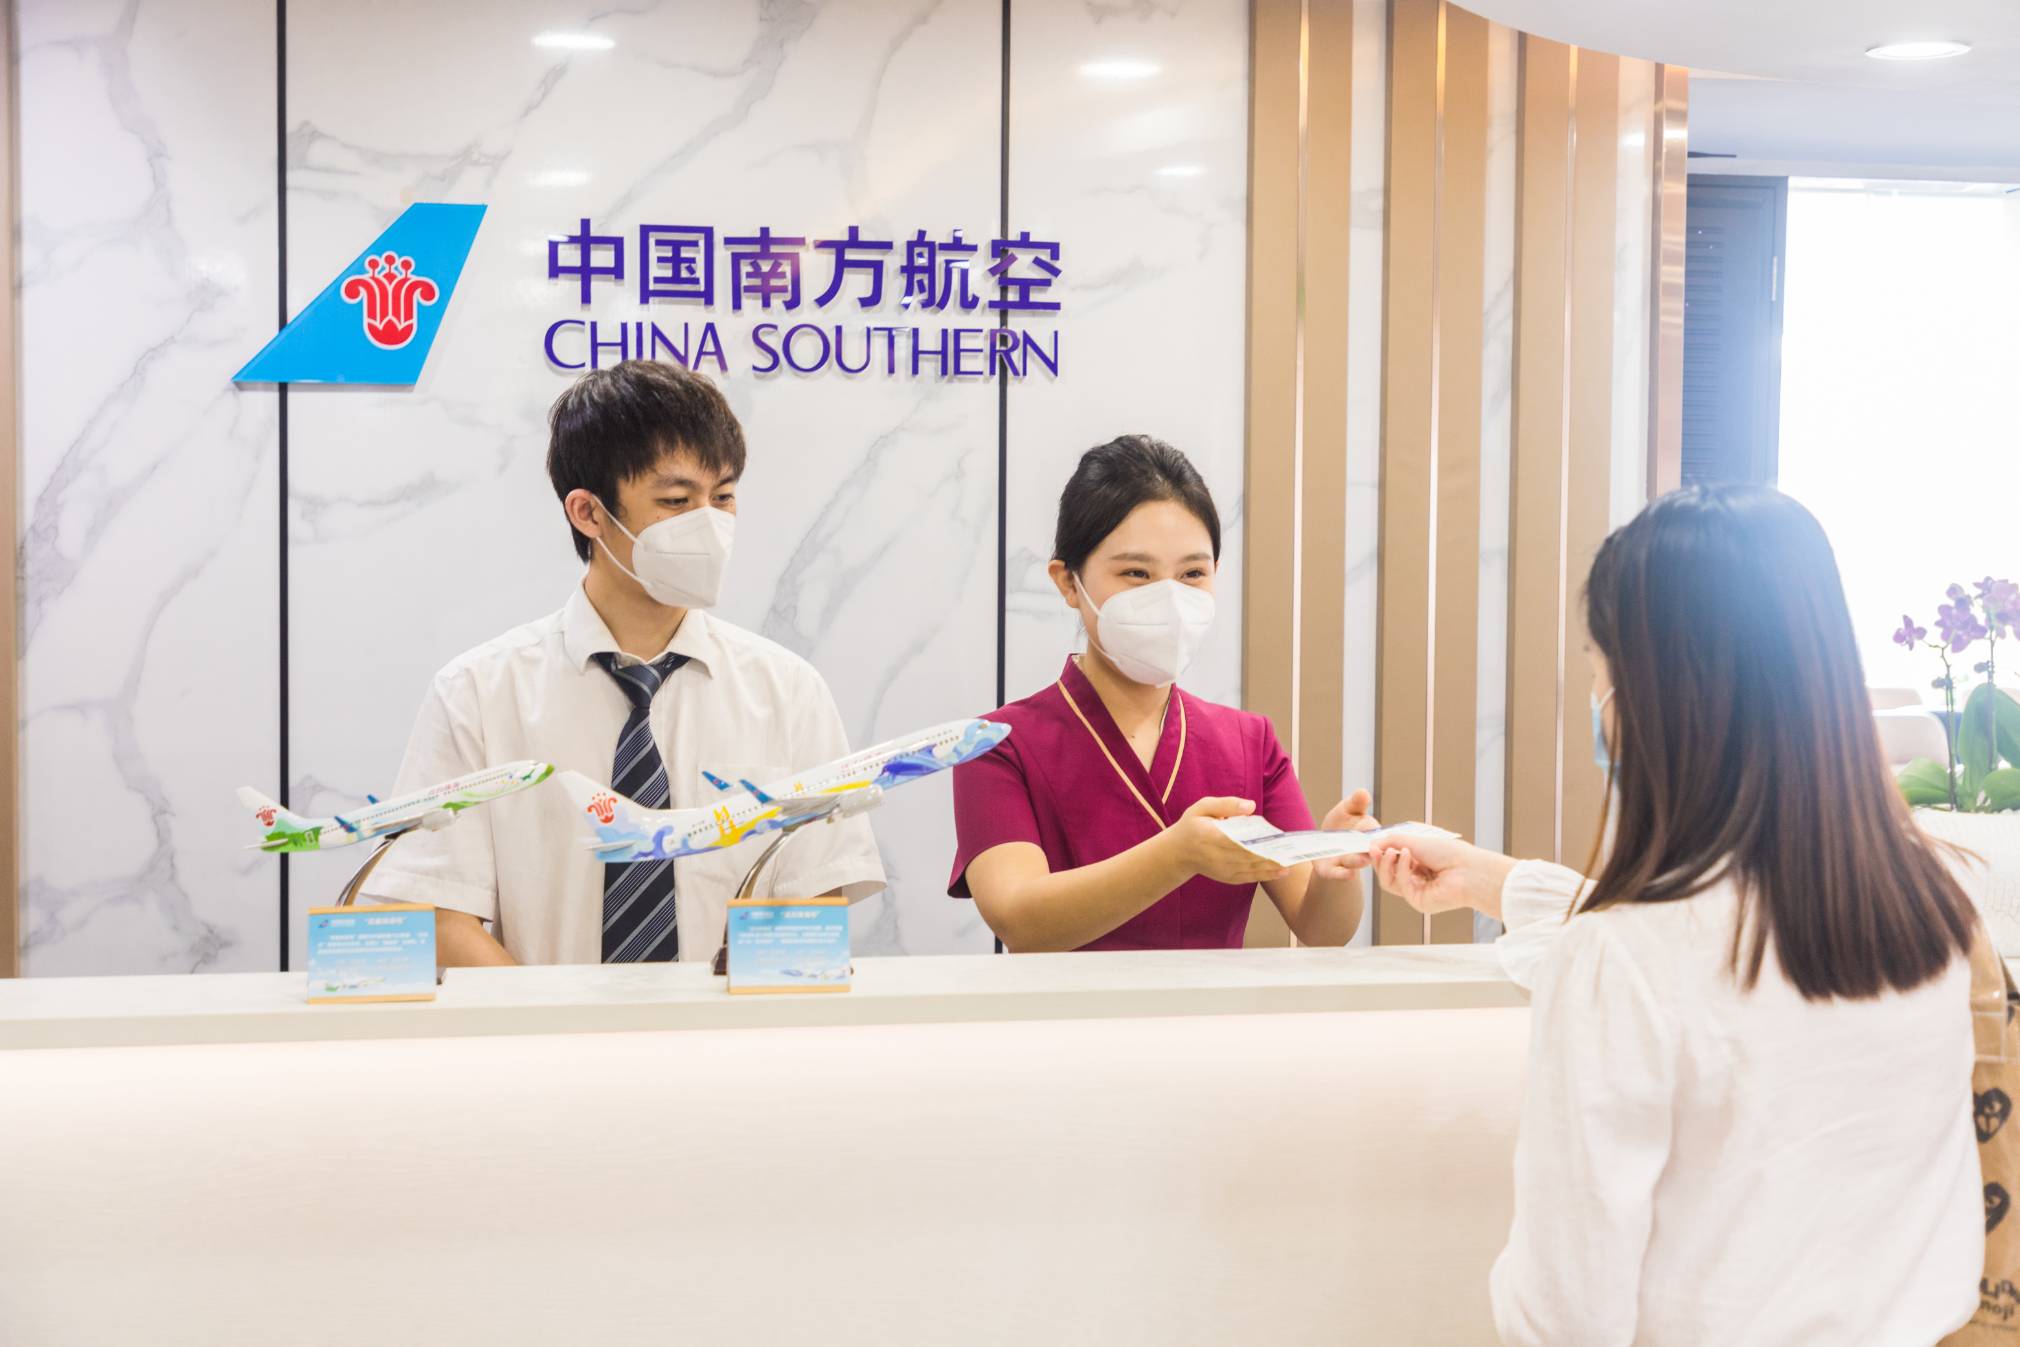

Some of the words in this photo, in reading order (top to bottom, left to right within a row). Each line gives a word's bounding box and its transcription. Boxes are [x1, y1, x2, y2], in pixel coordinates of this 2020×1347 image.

[548, 218, 1062, 311] 中国南方航空
[544, 319, 728, 372] CHINA
[752, 323, 1059, 377] SOUTHERN
